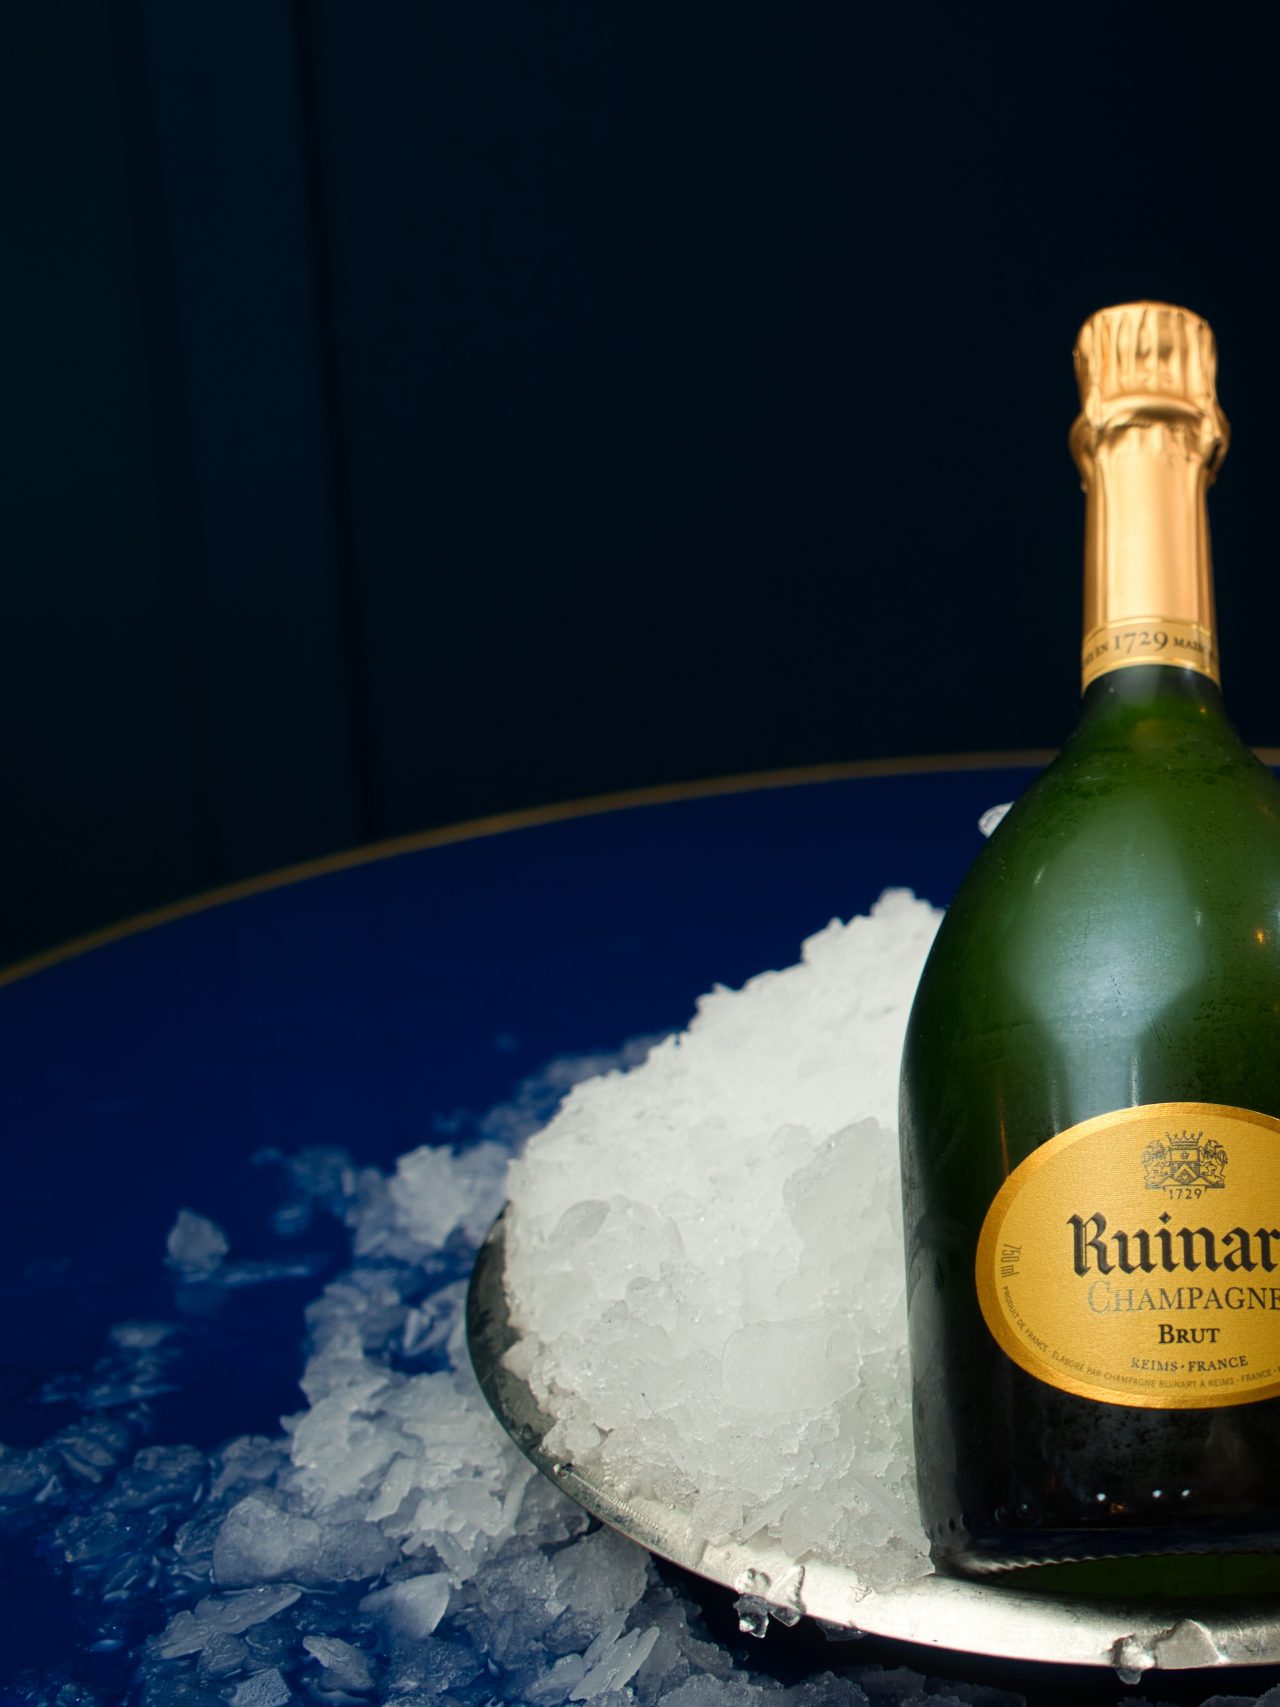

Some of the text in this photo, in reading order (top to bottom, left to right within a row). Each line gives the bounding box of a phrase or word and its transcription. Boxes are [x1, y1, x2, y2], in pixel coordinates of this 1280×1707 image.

[1113, 631, 1169, 654] 1729
[1169, 1188, 1202, 1200] 1729
[1000, 1243, 1022, 1278] 750 ml
[1002, 1285, 1020, 1319] PRODUIT
[1016, 1319, 1026, 1331] DE
[1024, 1328, 1049, 1353] FRANCE
[1103, 1372, 1156, 1388] CHAMPAGNE
[1159, 1380, 1196, 1389] RUINART
[1208, 1377, 1234, 1388] REIMS
[1241, 1368, 1273, 1383] FRANCE
[1130, 1355, 1249, 1373] REIMS FRANCE
